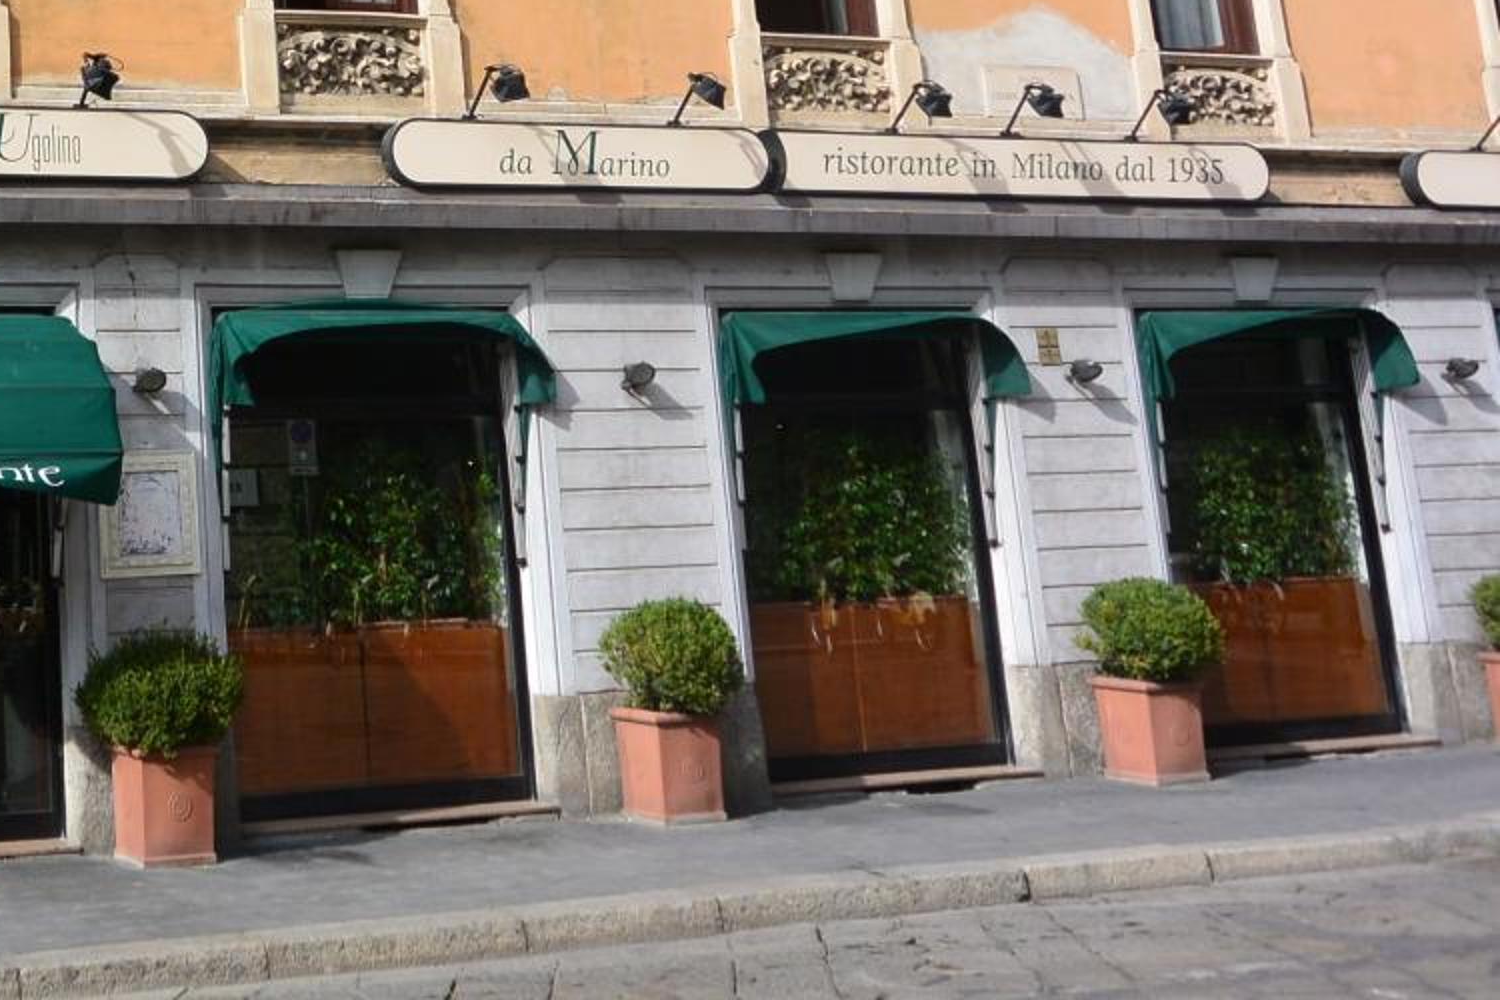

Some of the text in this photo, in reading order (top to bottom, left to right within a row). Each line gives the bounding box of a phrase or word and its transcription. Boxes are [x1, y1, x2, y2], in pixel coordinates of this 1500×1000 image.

[499, 129, 670, 177] da Marino
[823, 146, 1224, 185] ristorante in Milano dal 1935
